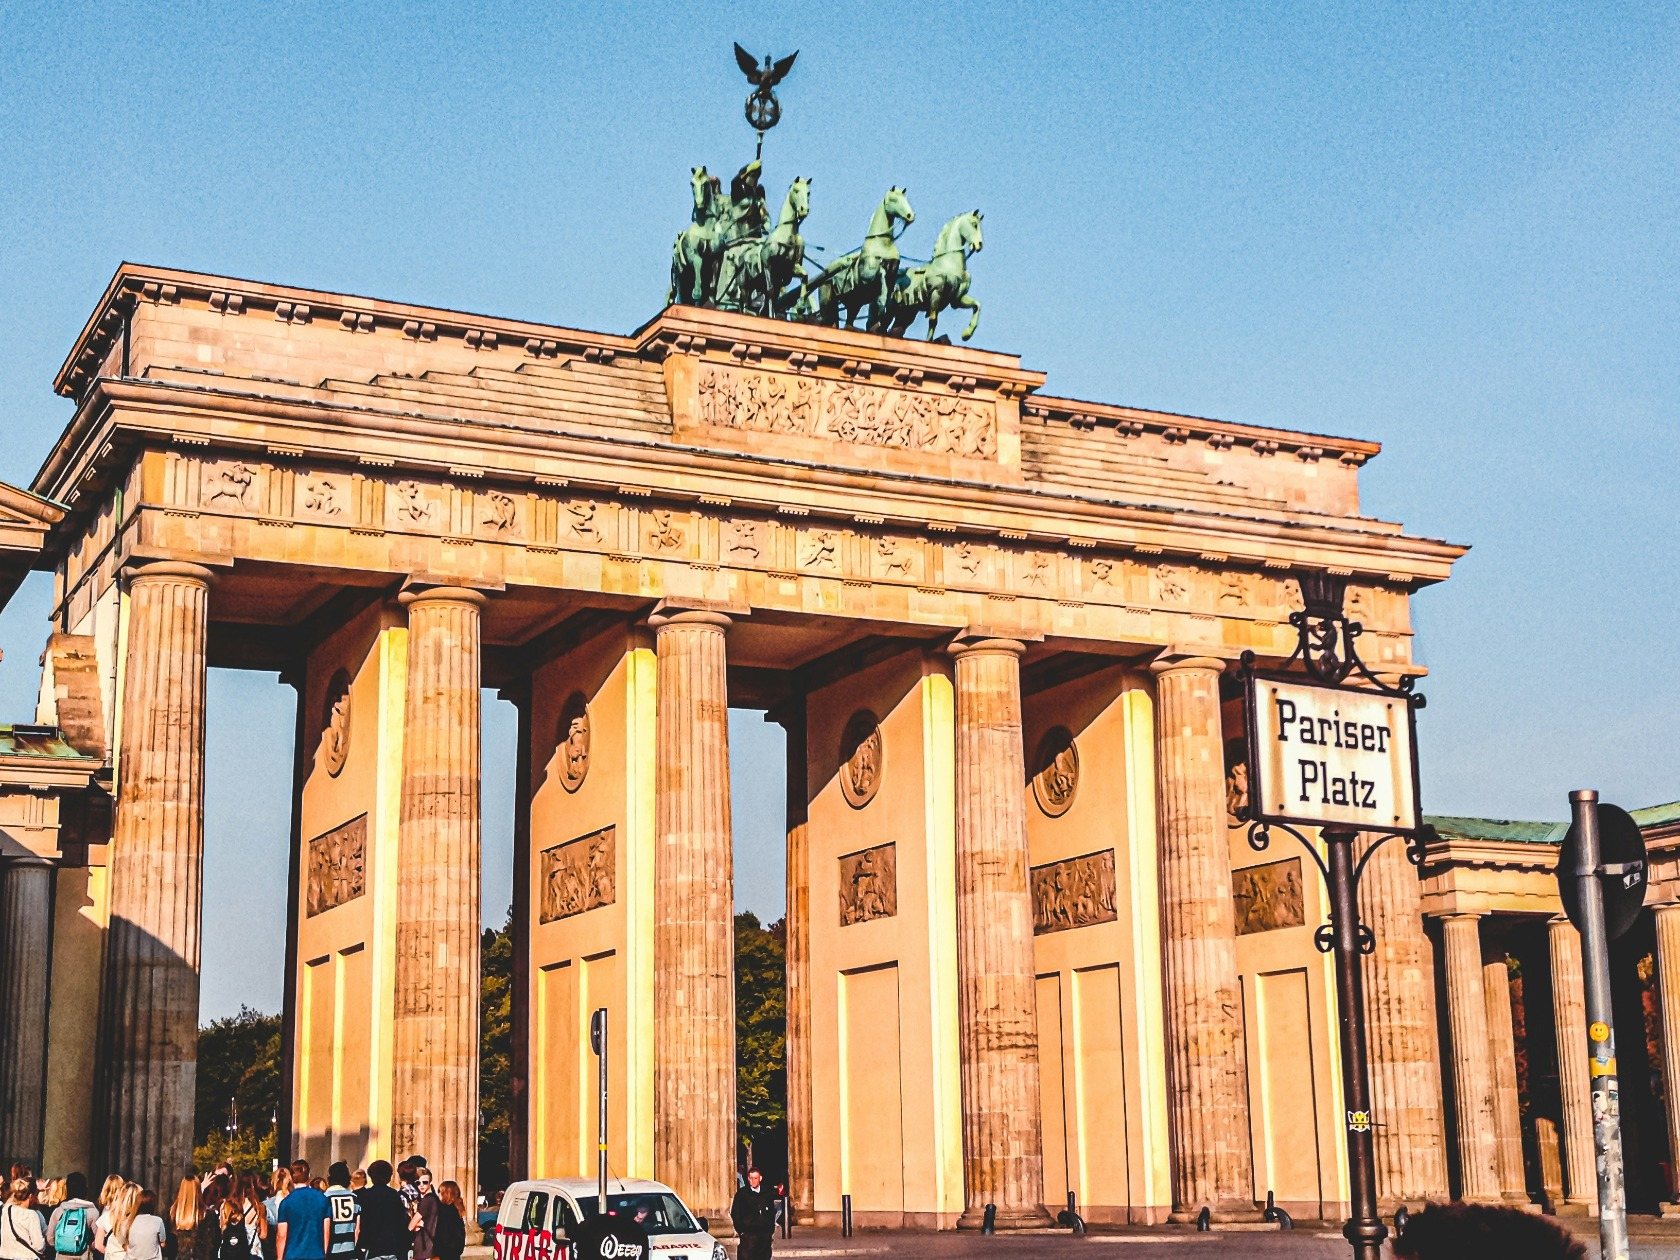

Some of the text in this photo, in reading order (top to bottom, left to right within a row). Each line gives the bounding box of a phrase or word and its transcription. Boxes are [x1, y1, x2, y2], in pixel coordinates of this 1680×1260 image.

[1275, 698, 1391, 753] Pariser
[1298, 758, 1377, 809] Platz
[334, 1198, 352, 1219] 15
